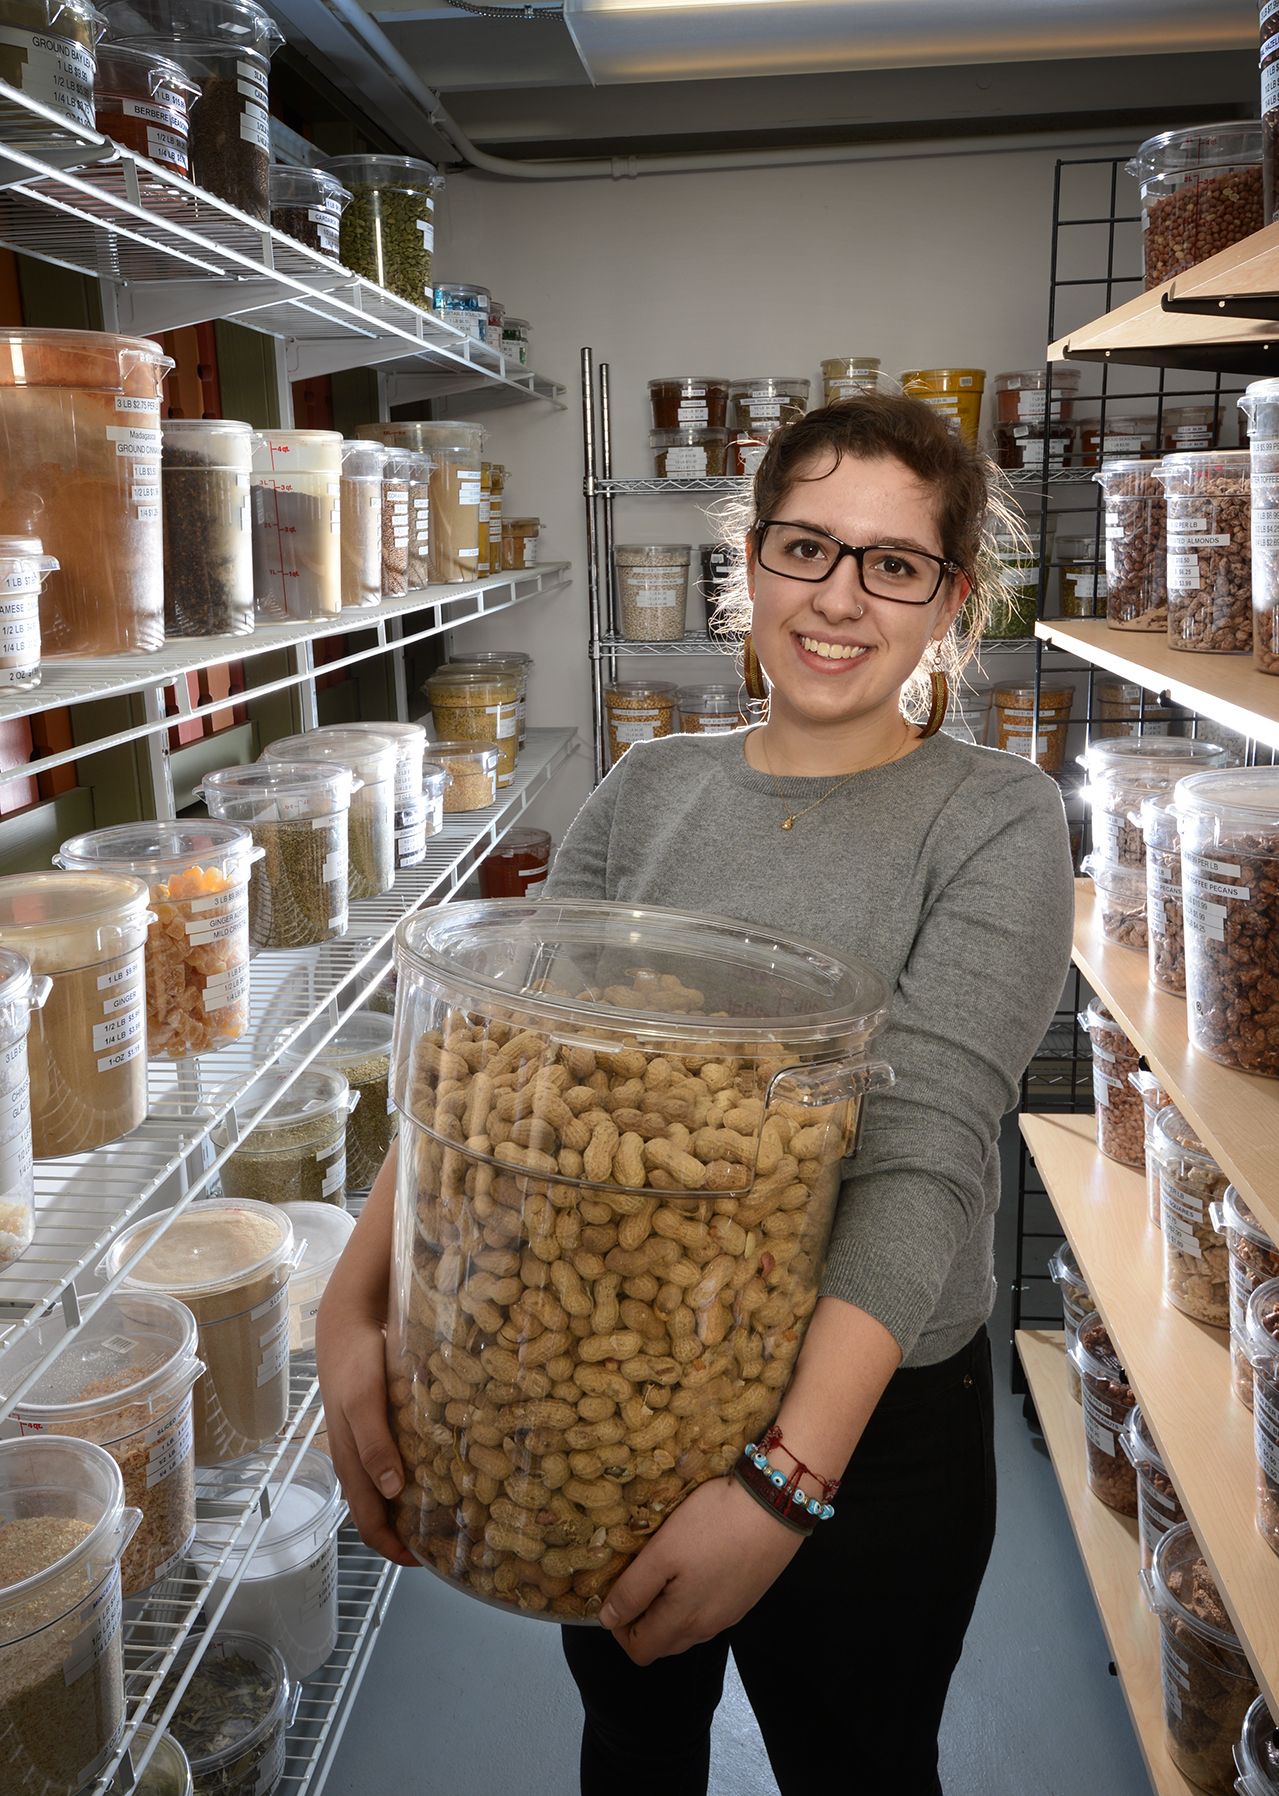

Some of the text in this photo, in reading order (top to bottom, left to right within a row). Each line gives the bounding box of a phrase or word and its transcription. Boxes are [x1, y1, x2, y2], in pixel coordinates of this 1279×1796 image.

[32, 36, 70, 56] GROUND
[72, 50, 82, 63] BAY
[58, 60, 61, 69] 1
[64, 62, 72, 74] LB
[54, 75, 64, 87] 1/2
[67, 80, 75, 91] LB
[54, 92, 65, 103] 1/4
[67, 97, 75, 107] LB
[162, 92, 170, 102] LB
[134, 105, 169, 122] BERBERE
[167, 136, 174, 145] LB
[168, 151, 176, 160] LB
[117, 400, 122, 408] 3
[124, 400, 132, 409] LB
[130, 430, 156, 441] Madagasca
[117, 443, 145, 453] GROUND
[139, 467, 146, 476] LB
[134, 488, 142, 496] 1/2
[6, 579, 10, 587] 1
[12, 577, 22, 587] LB
[2, 625, 24, 635] 1/2 LB
[3, 642, 25, 652] 1/4 LB
[16, 671, 25, 680] OZ
[1198, 859, 1218, 870] PER LB
[1210, 883, 1238, 895] PECANS
[220, 895, 227, 904] LB
[209, 913, 234, 928] GINGER
[213, 926, 229, 939] MILD
[114, 972, 123, 982] LB
[231, 968, 238, 977] LB
[233, 980, 239, 989] LB
[113, 991, 136, 1009] GINGER
[104, 1023, 115, 1032] 1/2
[117, 1018, 126, 1028] LB
[104, 1036, 115, 1045] 1/4
[117, 1031, 126, 1041] LB
[1169, 1200, 1194, 1217] SQUARES
[157, 1417, 176, 1435] SLICED
[167, 1438, 174, 1446] LB
[169, 1449, 176, 1458] LB
[169, 1461, 176, 1470] LB
